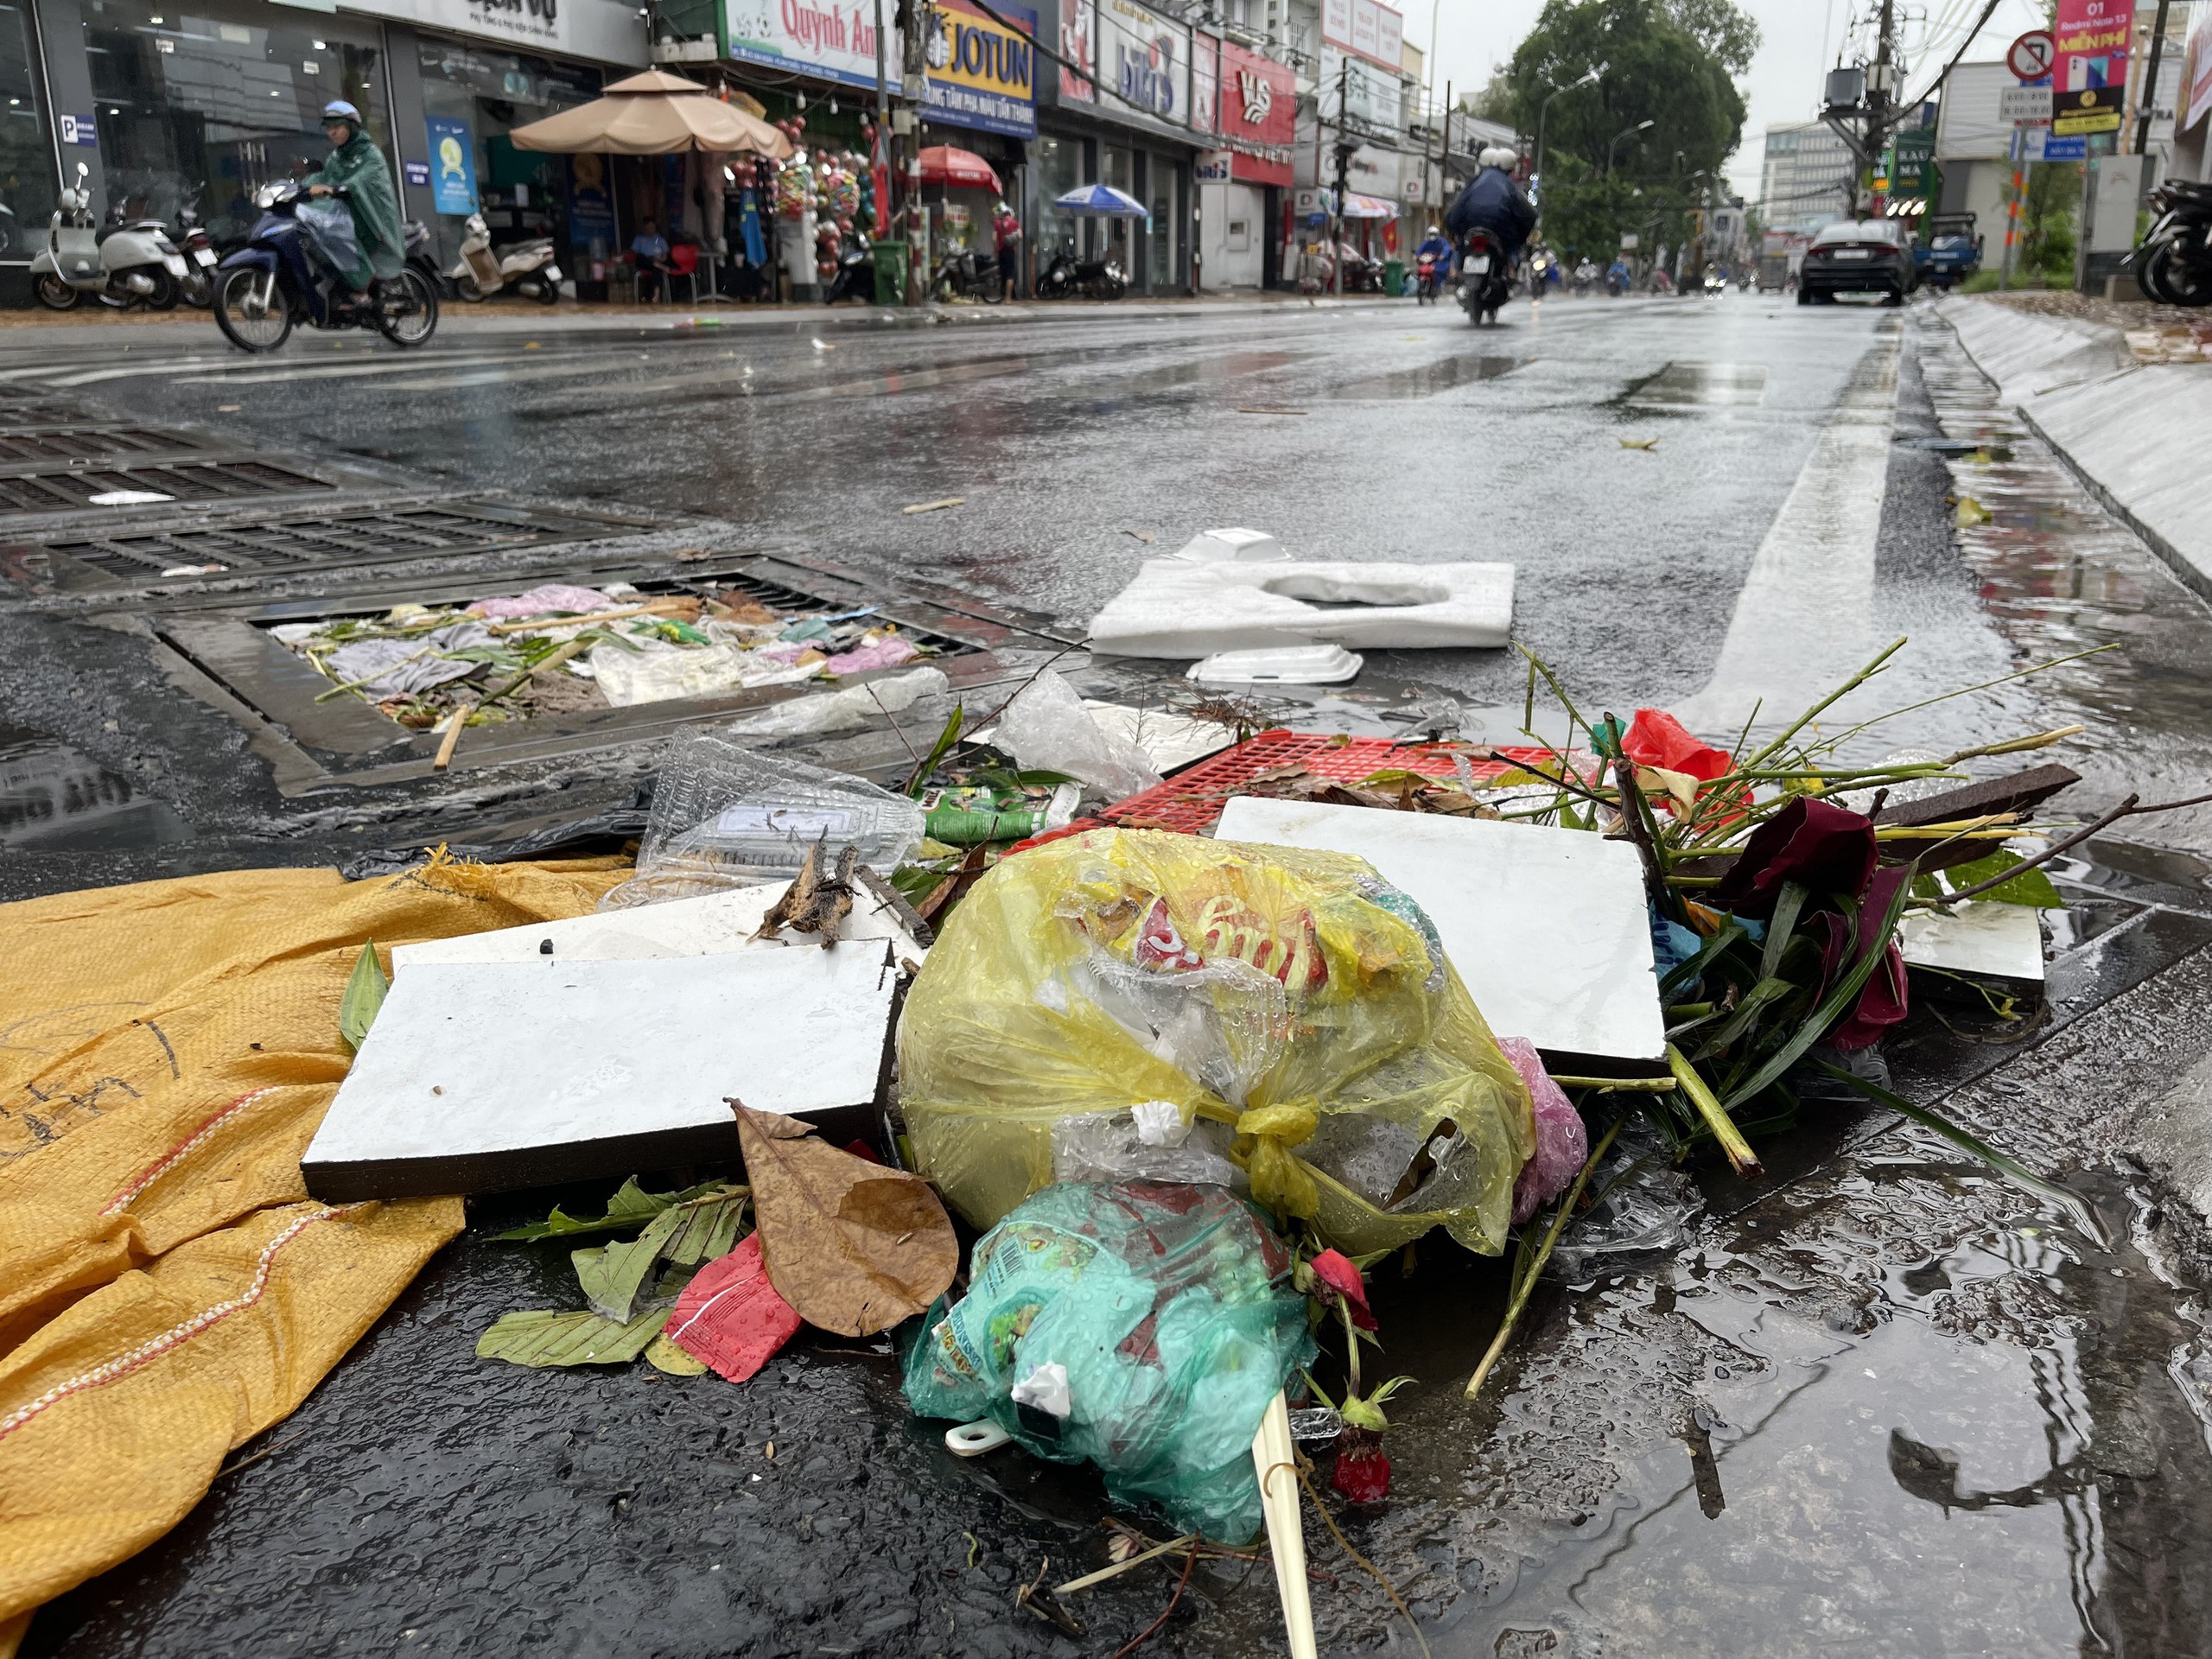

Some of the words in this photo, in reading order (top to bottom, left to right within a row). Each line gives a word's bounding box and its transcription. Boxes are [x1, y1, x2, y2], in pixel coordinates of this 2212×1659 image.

[2087, 1, 2105, 16] 01
[782, 0, 847, 55] Quỳnh
[852, 9, 880, 58] An
[2060, 19, 2092, 31] Redmi
[2093, 17, 2114, 28] Note
[2115, 13, 2127, 23] 13
[953, 22, 1030, 88] JOTUN
[1897, 149, 1929, 162] RAU
